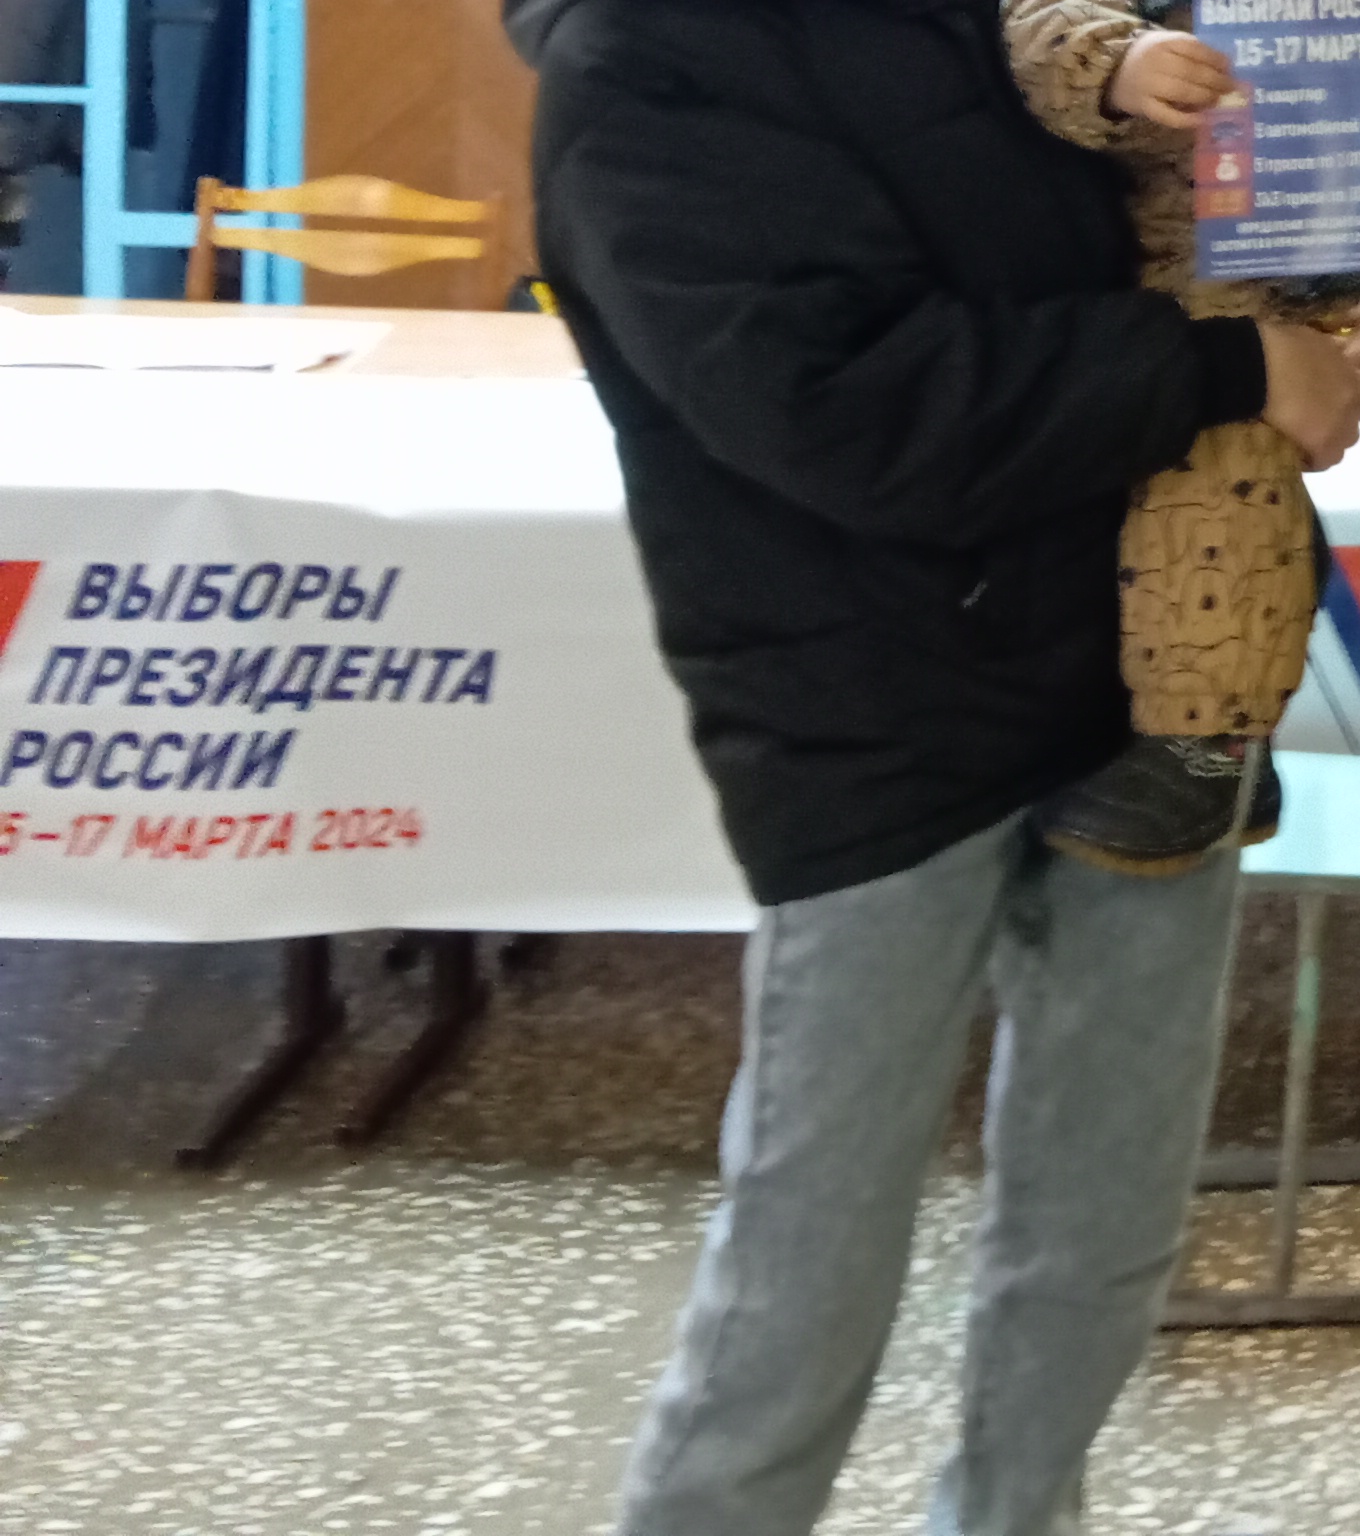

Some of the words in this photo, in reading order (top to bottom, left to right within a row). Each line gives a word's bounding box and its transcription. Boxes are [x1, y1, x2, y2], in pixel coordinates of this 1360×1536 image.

[64, 561, 402, 622] ВЫБОРЫ
[27, 643, 500, 713] ПРЕЗИДЕНТА
[0, 727, 299, 791] РОССИИ
[122, 810, 298, 860] МАРТА
[309, 806, 424, 852] 2024
